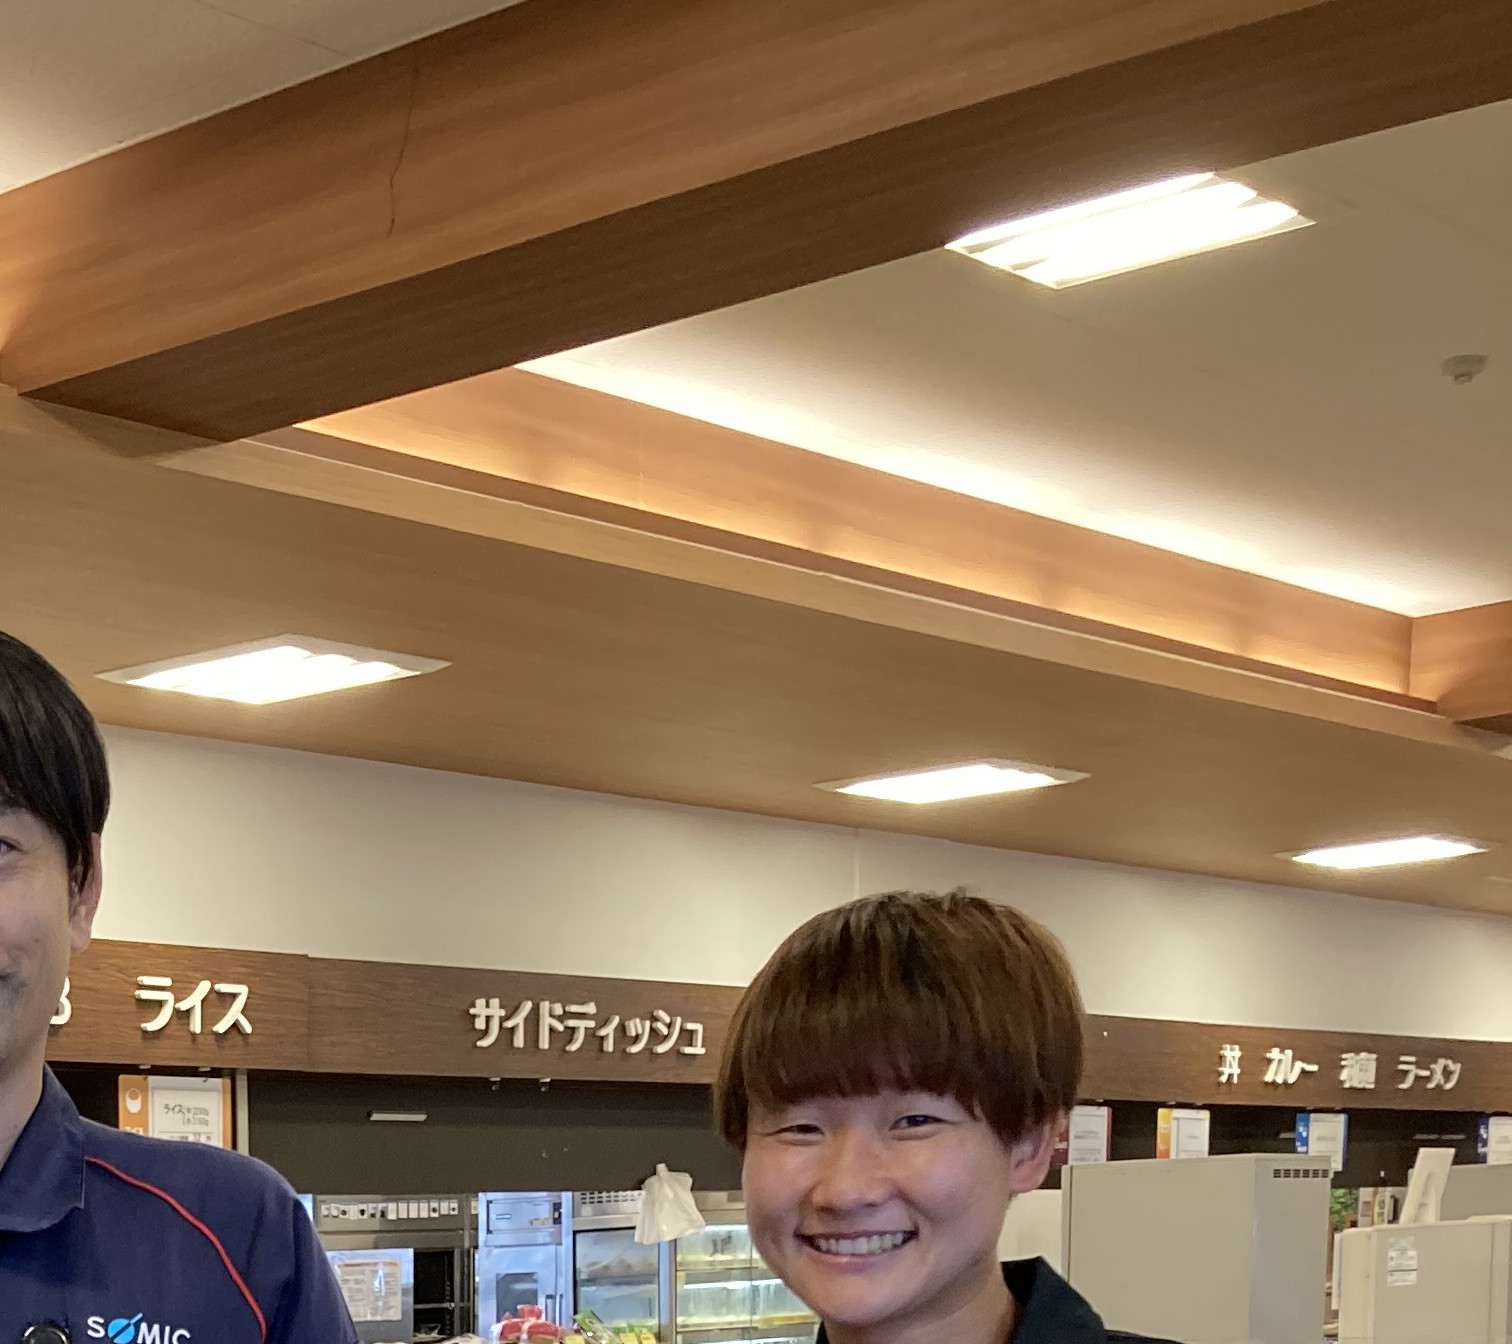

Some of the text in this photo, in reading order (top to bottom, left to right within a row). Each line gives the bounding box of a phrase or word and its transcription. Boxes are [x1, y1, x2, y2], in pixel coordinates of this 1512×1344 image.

[134, 975, 253, 1034] ライス
[469, 997, 706, 1055] サイドディッシュ
[1263, 1047, 1319, 1084] カレー
[1396, 1055, 1462, 1090] ラーメン
